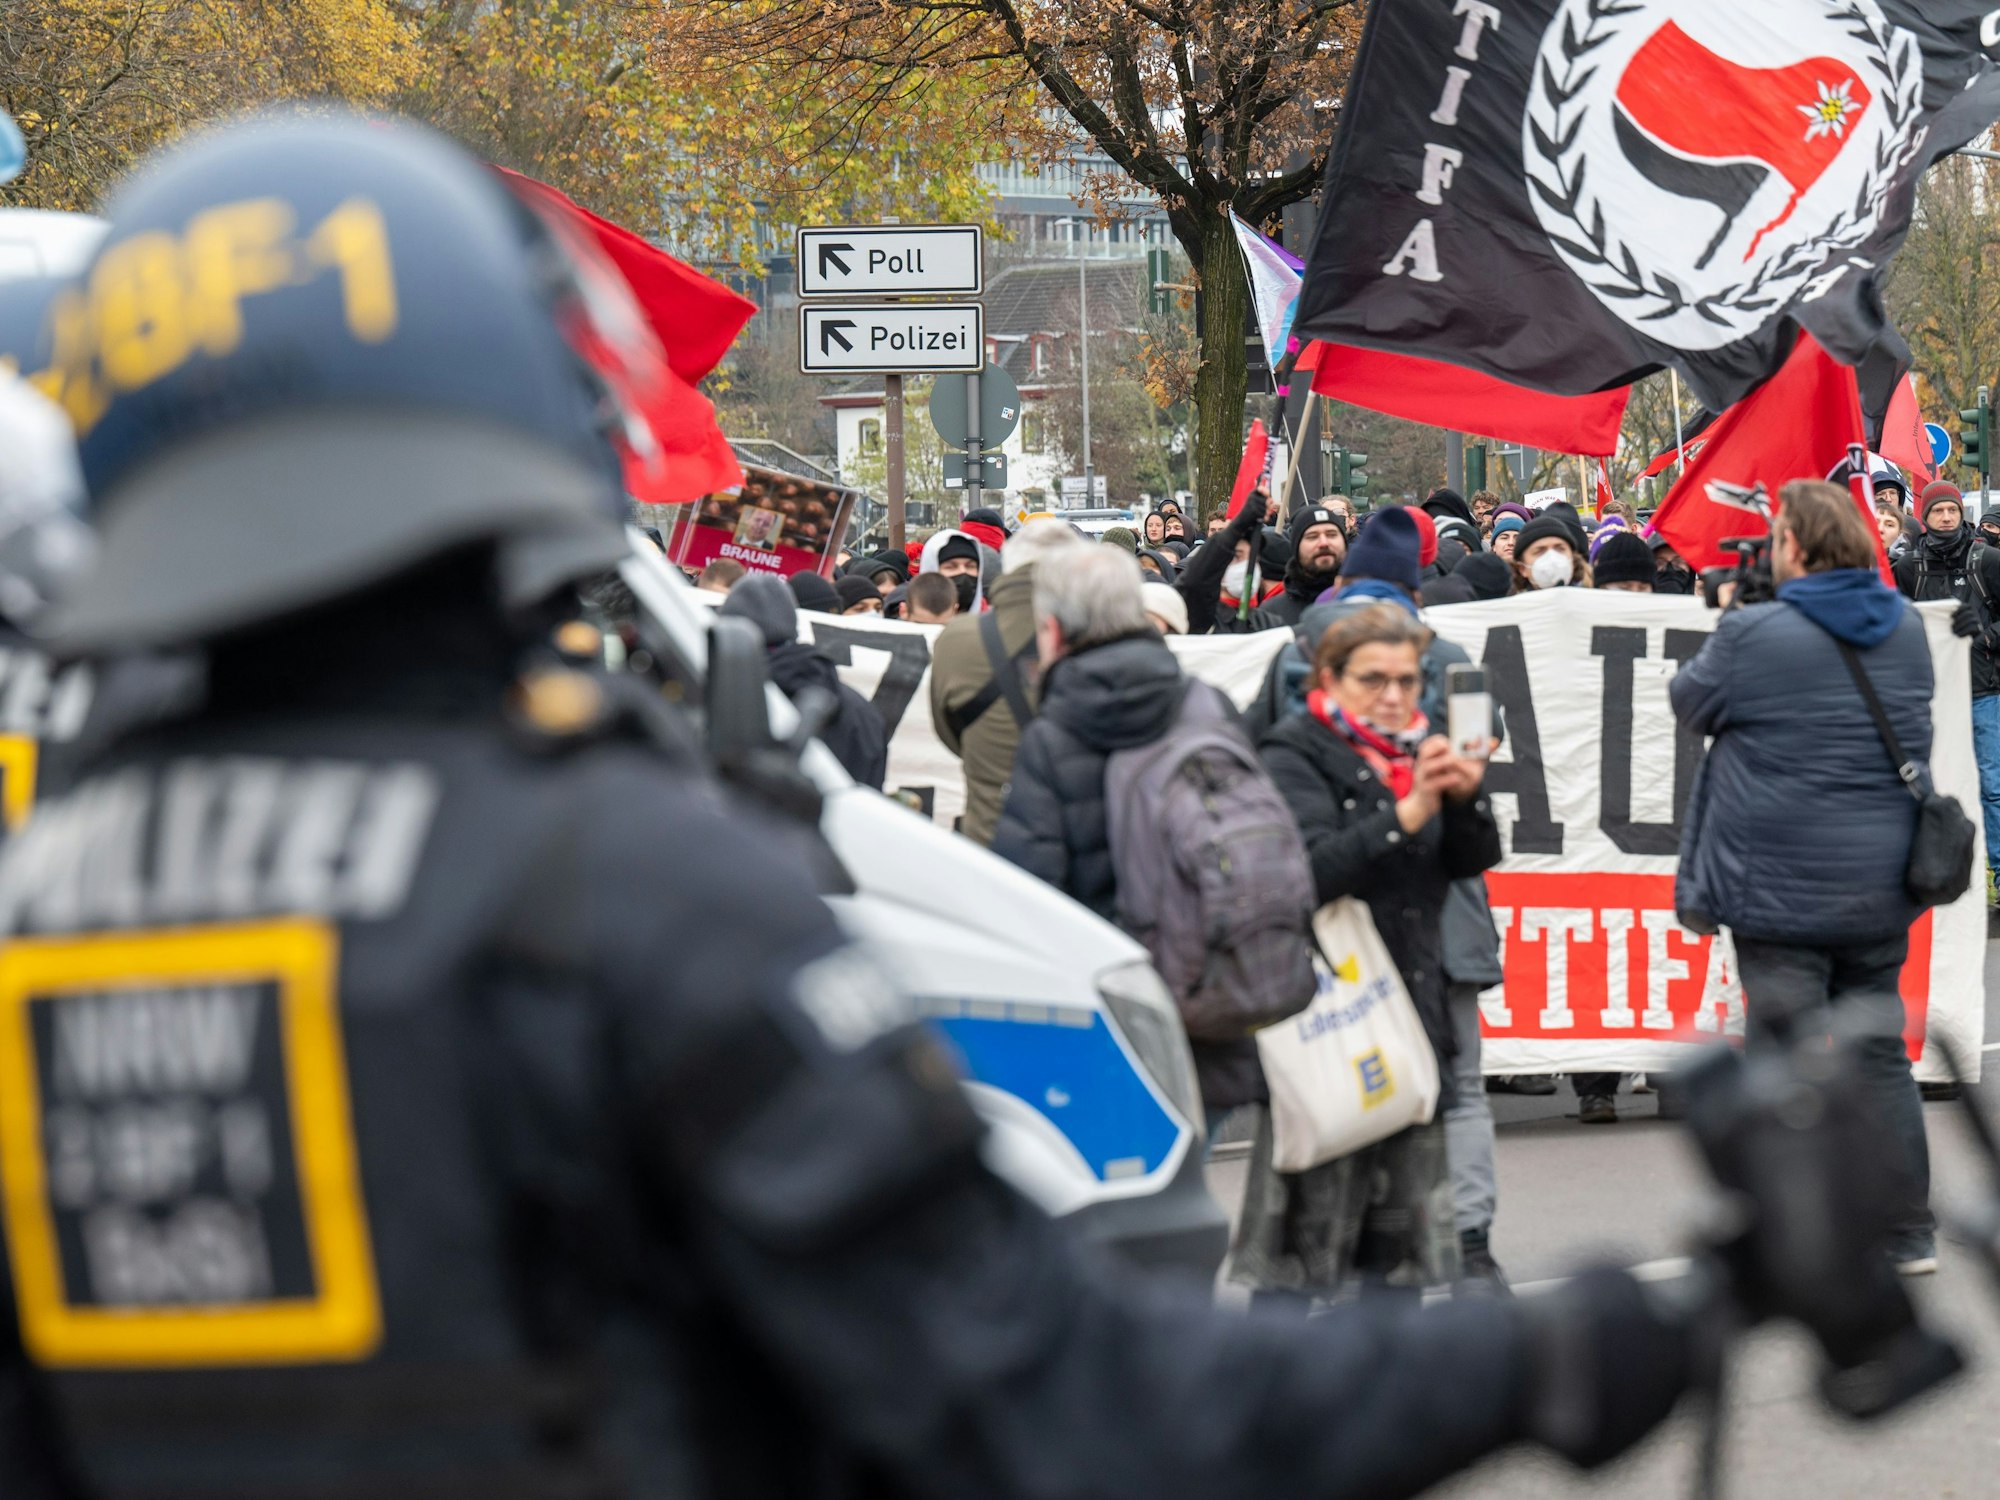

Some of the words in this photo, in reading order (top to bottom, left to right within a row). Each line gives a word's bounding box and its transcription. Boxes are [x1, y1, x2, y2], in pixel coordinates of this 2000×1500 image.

[868, 248, 924, 274] Poll
[871, 325, 965, 351] Polizei
[719, 543, 782, 568] BRAUNE
